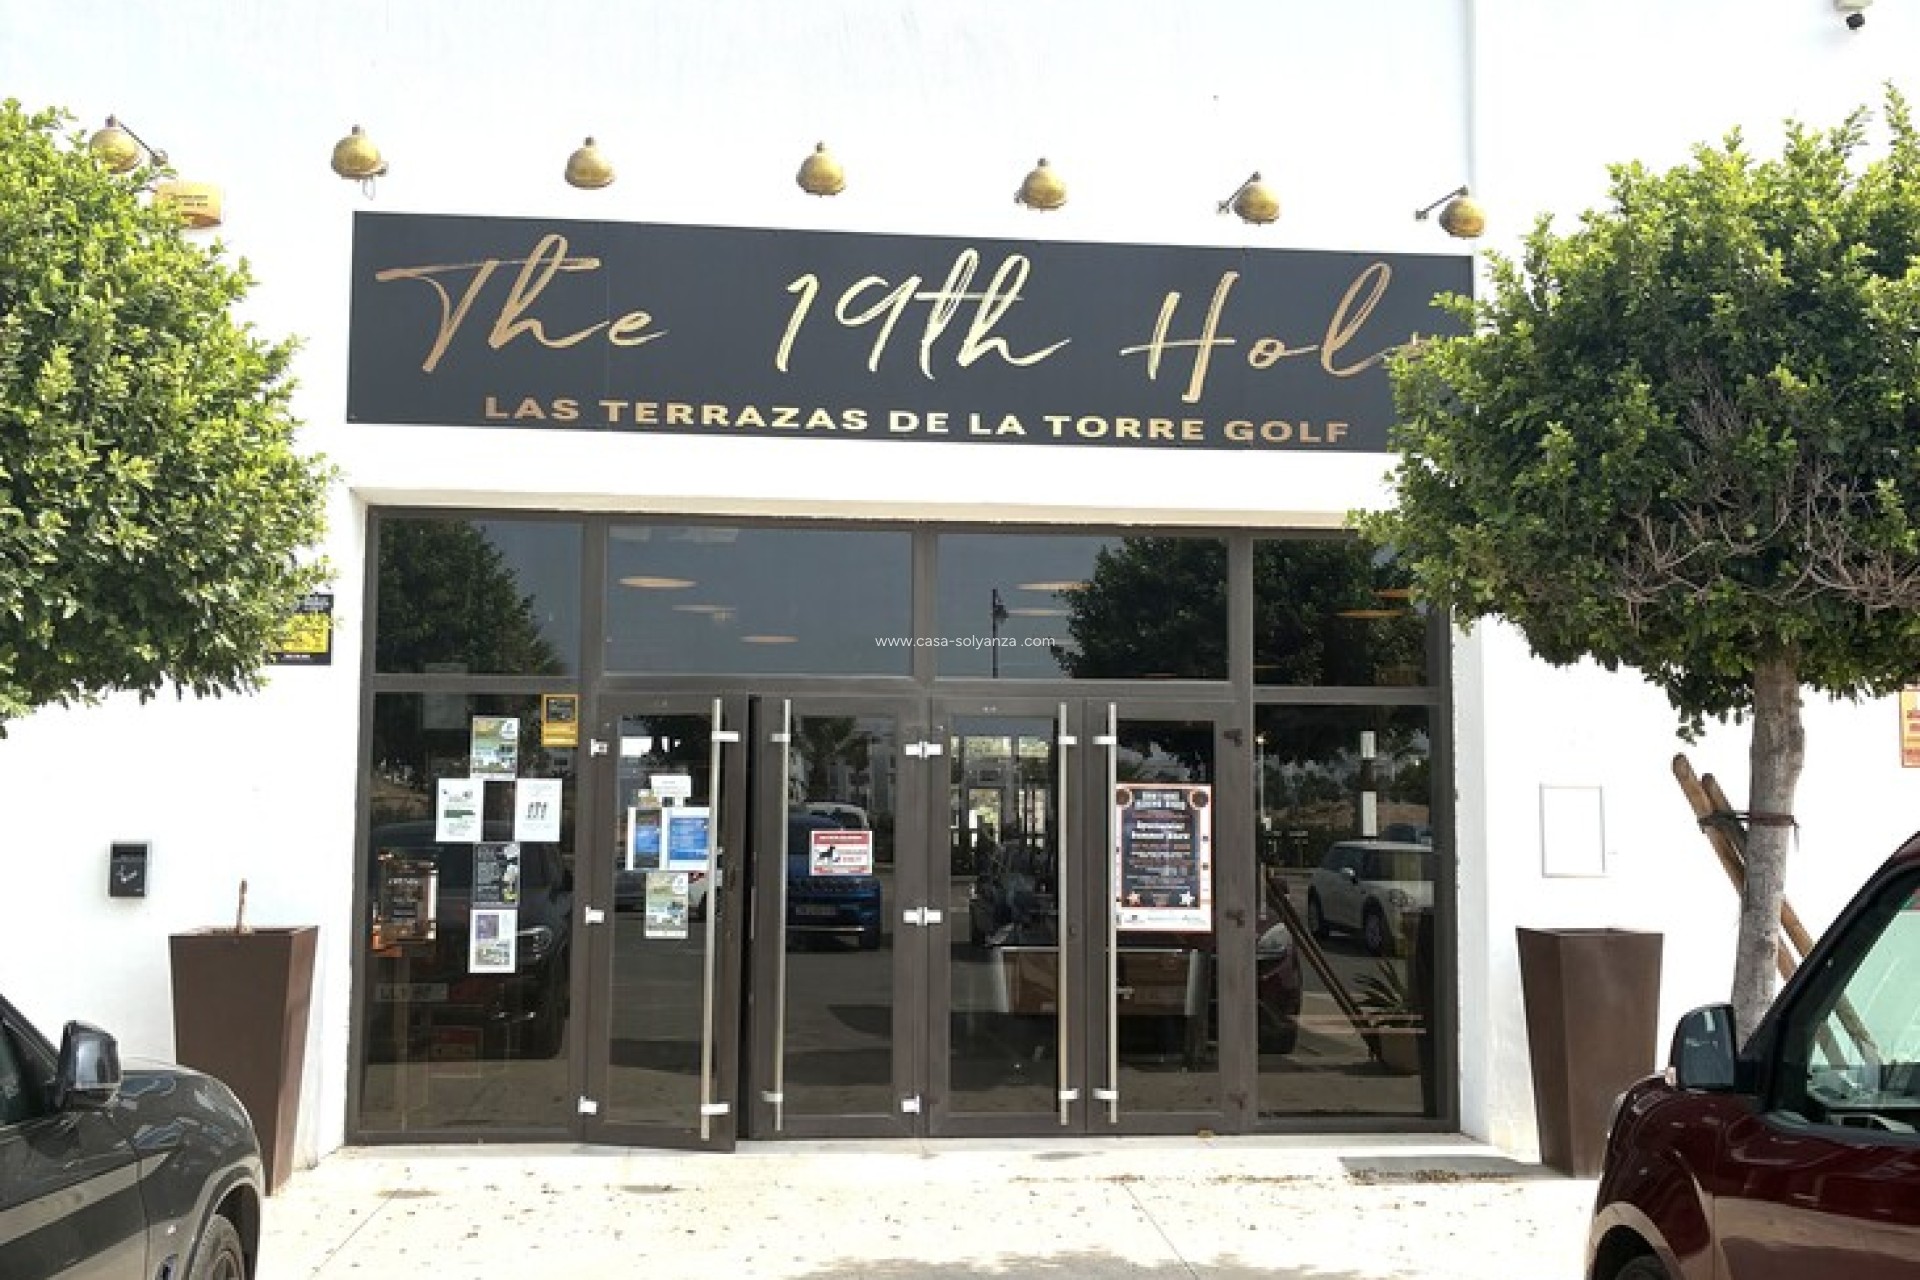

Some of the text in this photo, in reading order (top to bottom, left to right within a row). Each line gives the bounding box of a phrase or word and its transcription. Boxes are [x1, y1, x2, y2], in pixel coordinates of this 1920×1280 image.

[375, 233, 1432, 403] The 19th Hol
[485, 395, 1349, 443] LAS TERRAZAS DE LA TORRE GOLF
